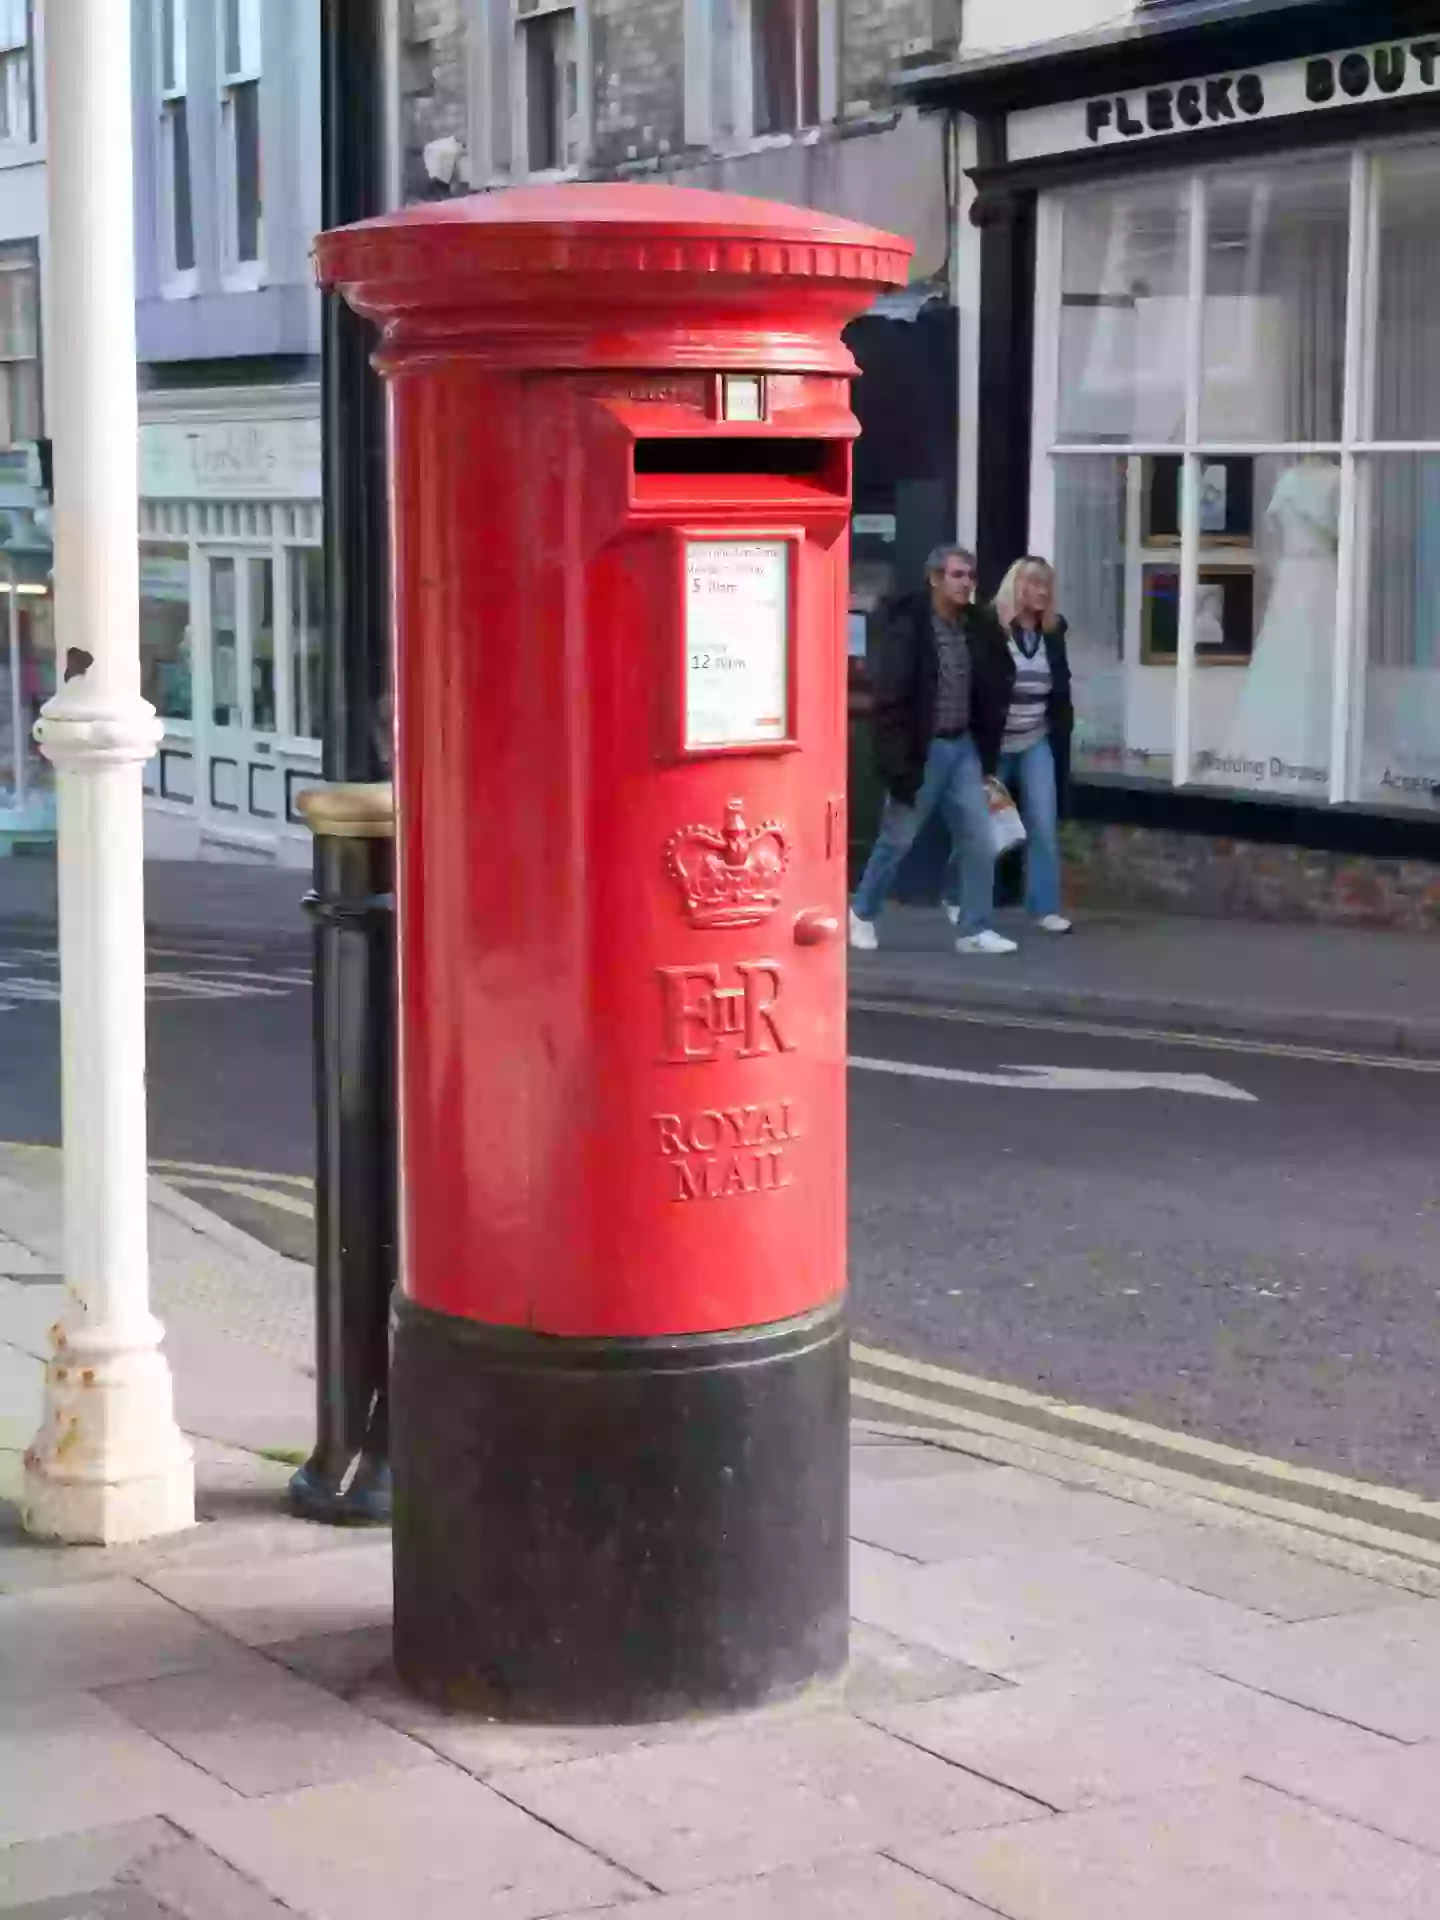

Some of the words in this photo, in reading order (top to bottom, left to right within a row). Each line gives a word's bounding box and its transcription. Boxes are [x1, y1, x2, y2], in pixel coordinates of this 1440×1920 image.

[1305, 40, 1440, 103] BOUT
[691, 654, 711, 670] 12
[651, 1099, 801, 1155] ROYAL
[670, 1147, 791, 1202] MAIL
